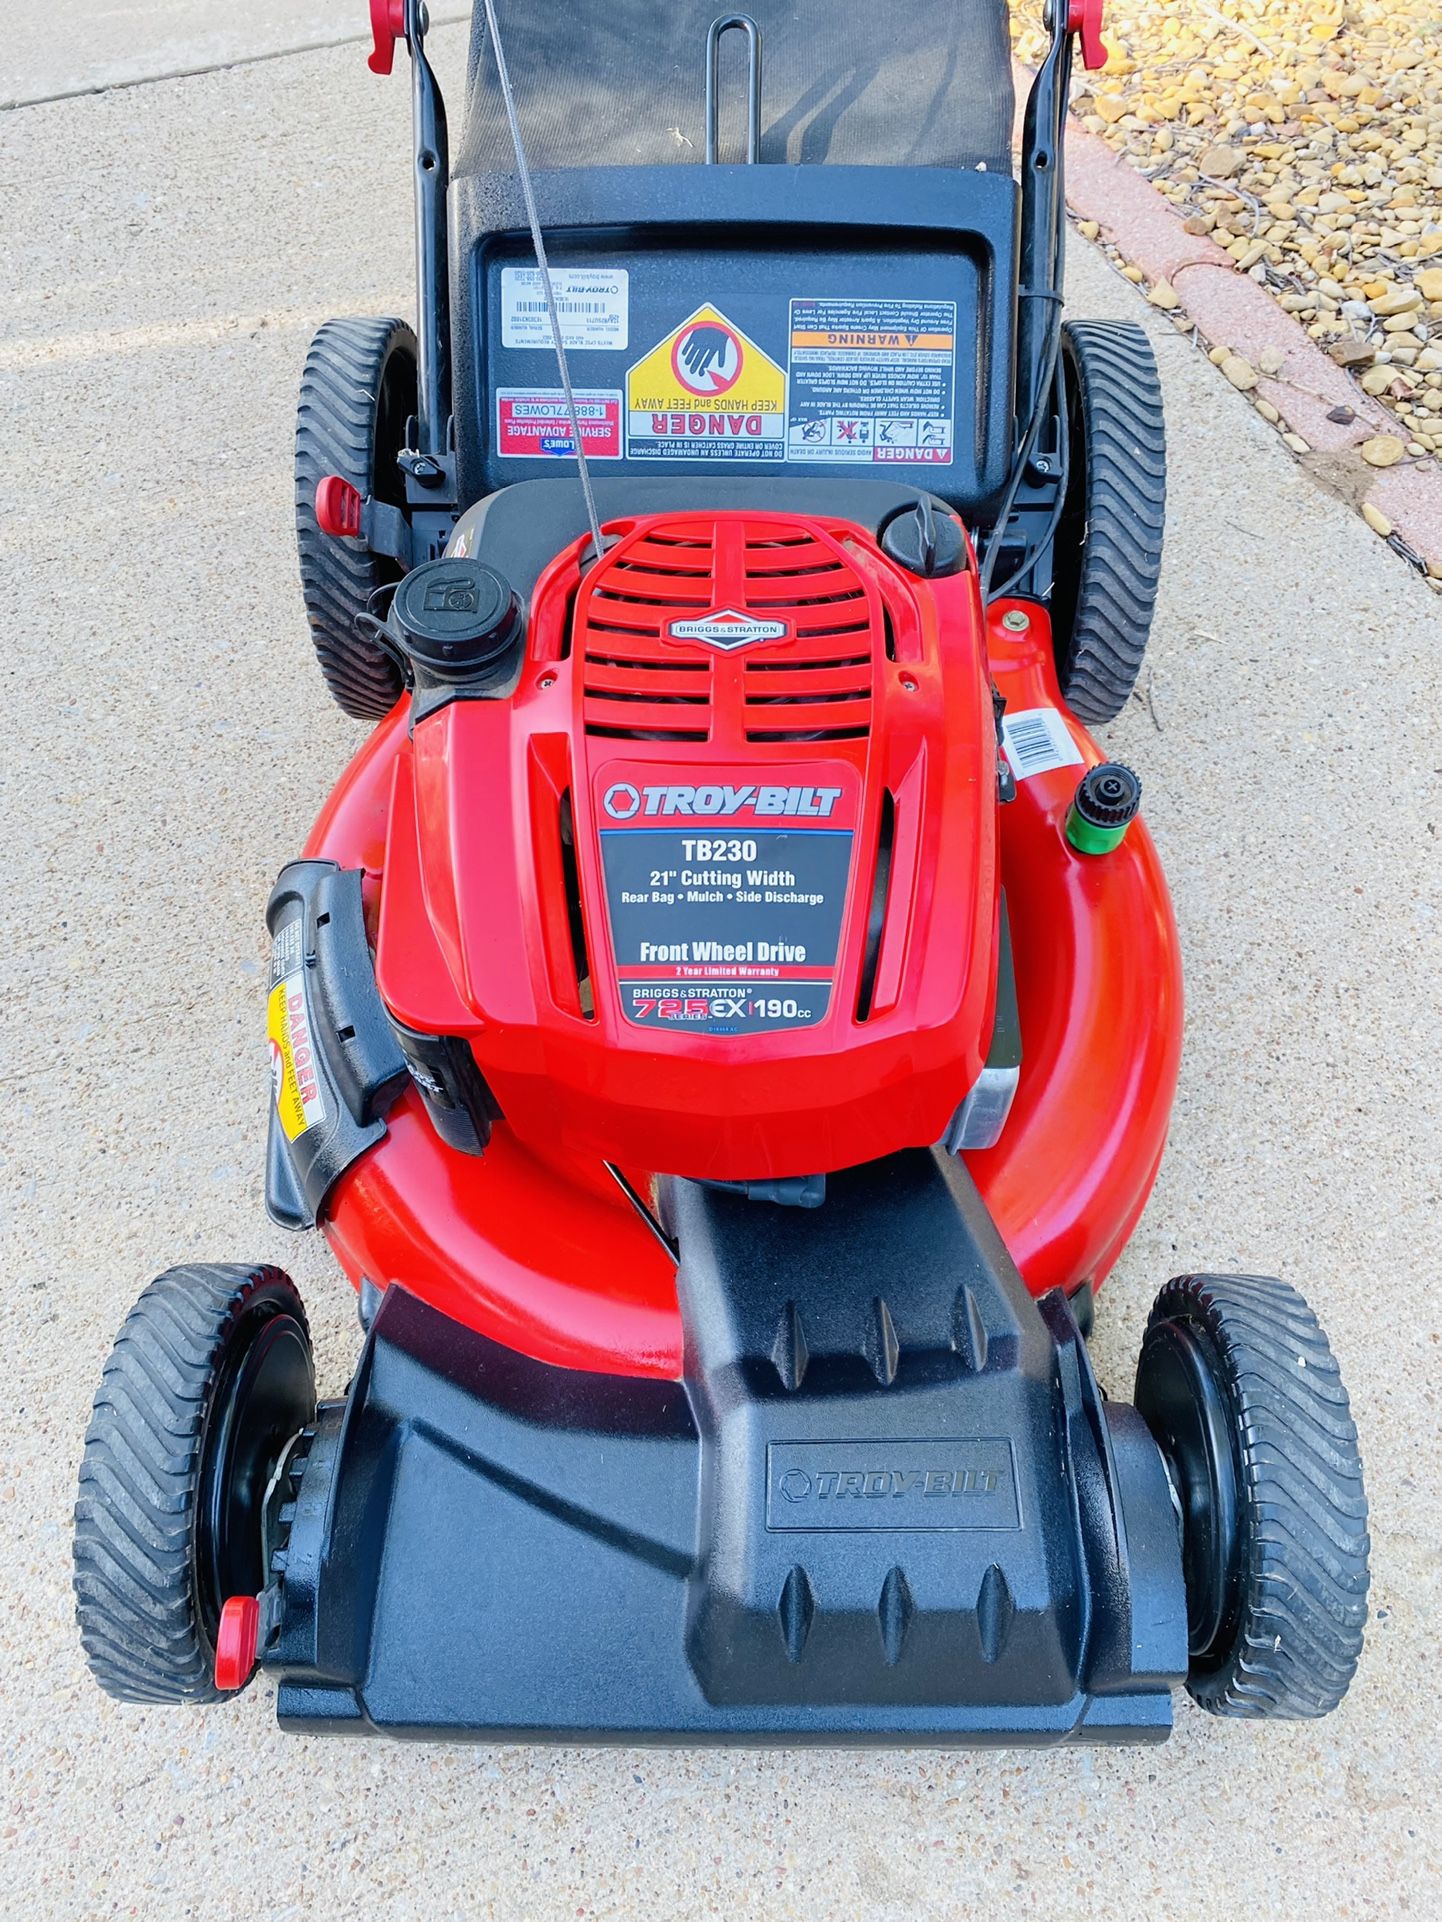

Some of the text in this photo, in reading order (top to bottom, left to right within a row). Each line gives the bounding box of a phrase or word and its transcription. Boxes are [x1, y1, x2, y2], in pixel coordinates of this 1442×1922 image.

[828, 334, 899, 345] WARNING
[515, 405, 603, 416] 1-88877LOWES
[634, 398, 777, 411] KEEP HANDS and FEET AWAY
[507, 426, 566, 436] ADVANTAGE
[652, 414, 762, 435] DANGER
[543, 440, 574, 449] LOWE'S
[877, 448, 933, 459] DANGER
[642, 786, 842, 817] TROY-BILT
[682, 840, 757, 861] TB230
[650, 870, 795, 888] 21" Cutting Width
[621, 891, 824, 905] Rear Bag Mulch Side Discharge
[640, 942, 806, 962] Front Wheel Drive
[676, 967, 779, 977] 2 Year Limited Warranty
[280, 1013, 291, 1050] HANDS
[288, 992, 317, 1105] DANGER
[287, 1068, 298, 1094] FEET
[292, 1095, 306, 1127] AWAY
[816, 1470, 1003, 1499] TROY-BILT
